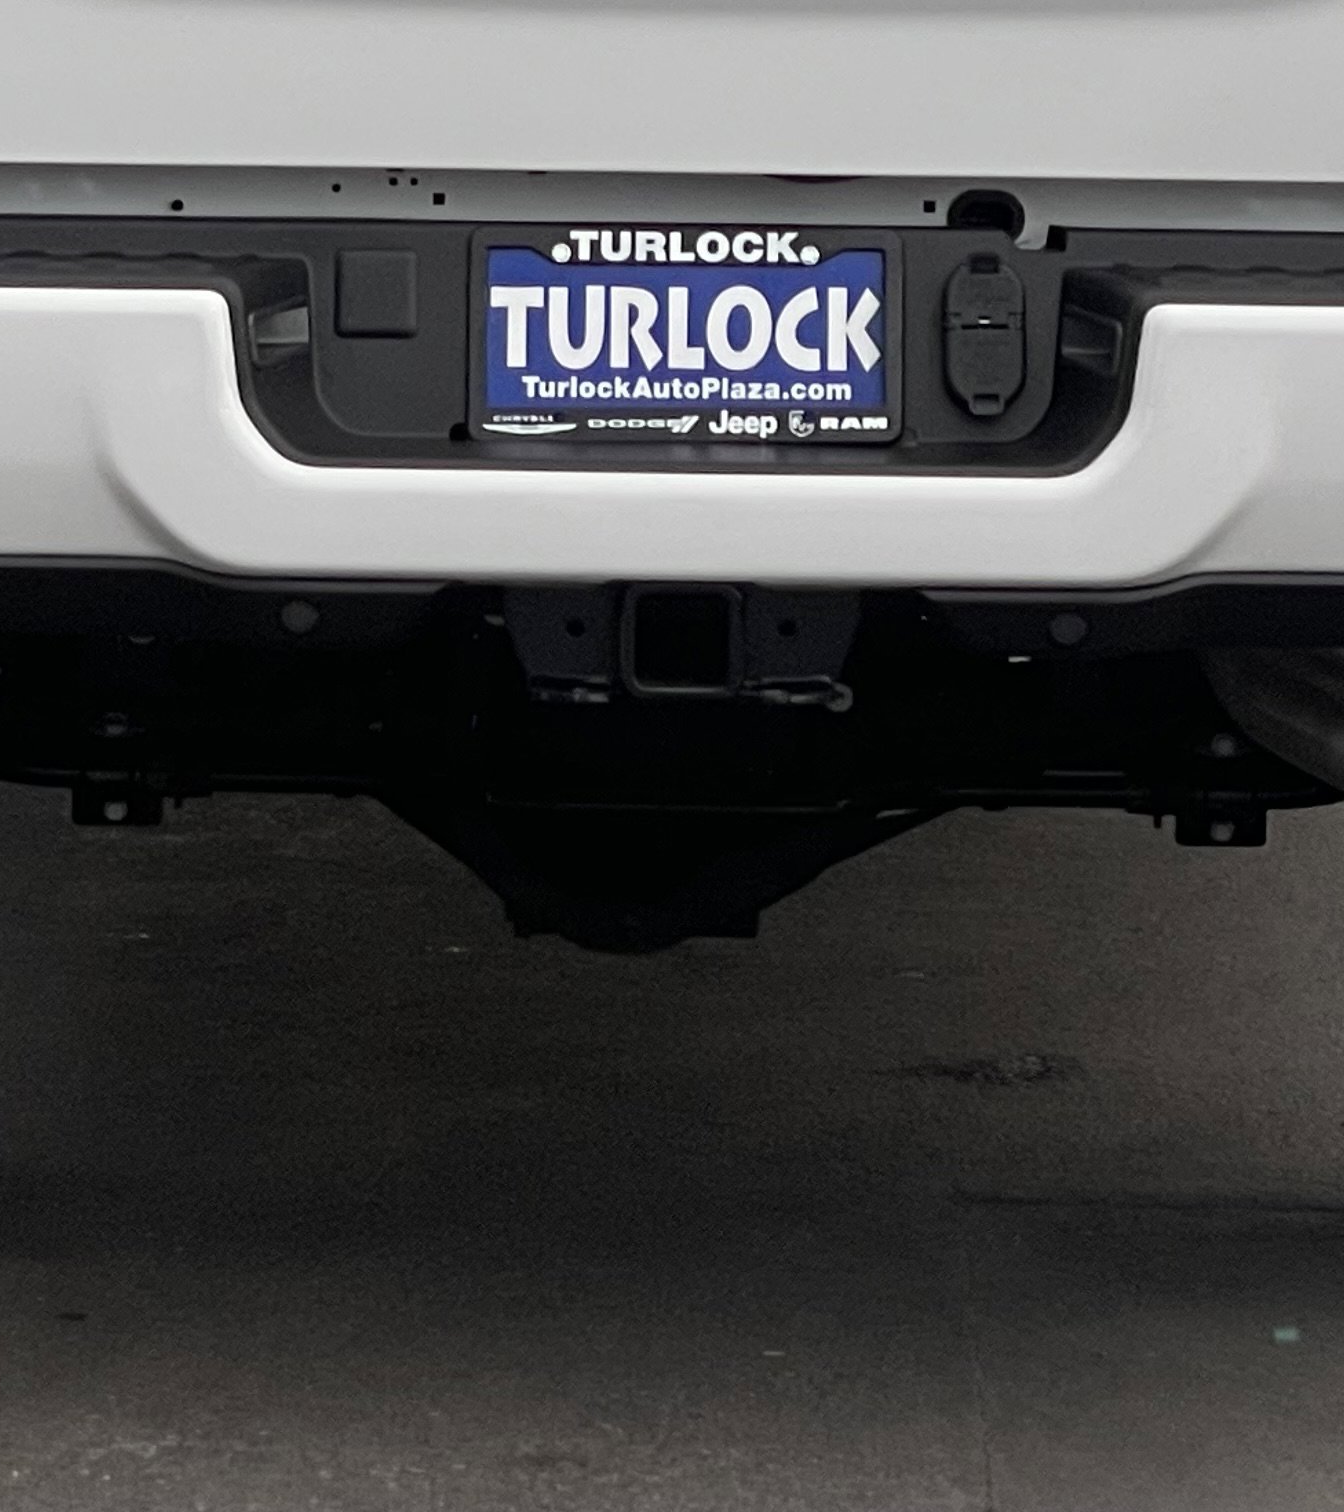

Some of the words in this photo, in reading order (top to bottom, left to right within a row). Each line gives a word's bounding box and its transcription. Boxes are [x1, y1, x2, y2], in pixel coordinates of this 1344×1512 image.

[569, 230, 800, 264] TURLOCK
[489, 285, 882, 372] TURLOCK
[521, 375, 853, 402] TurlockAutoPlaza.com
[708, 408, 778, 439] Jeep
[819, 416, 889, 431] RAM
